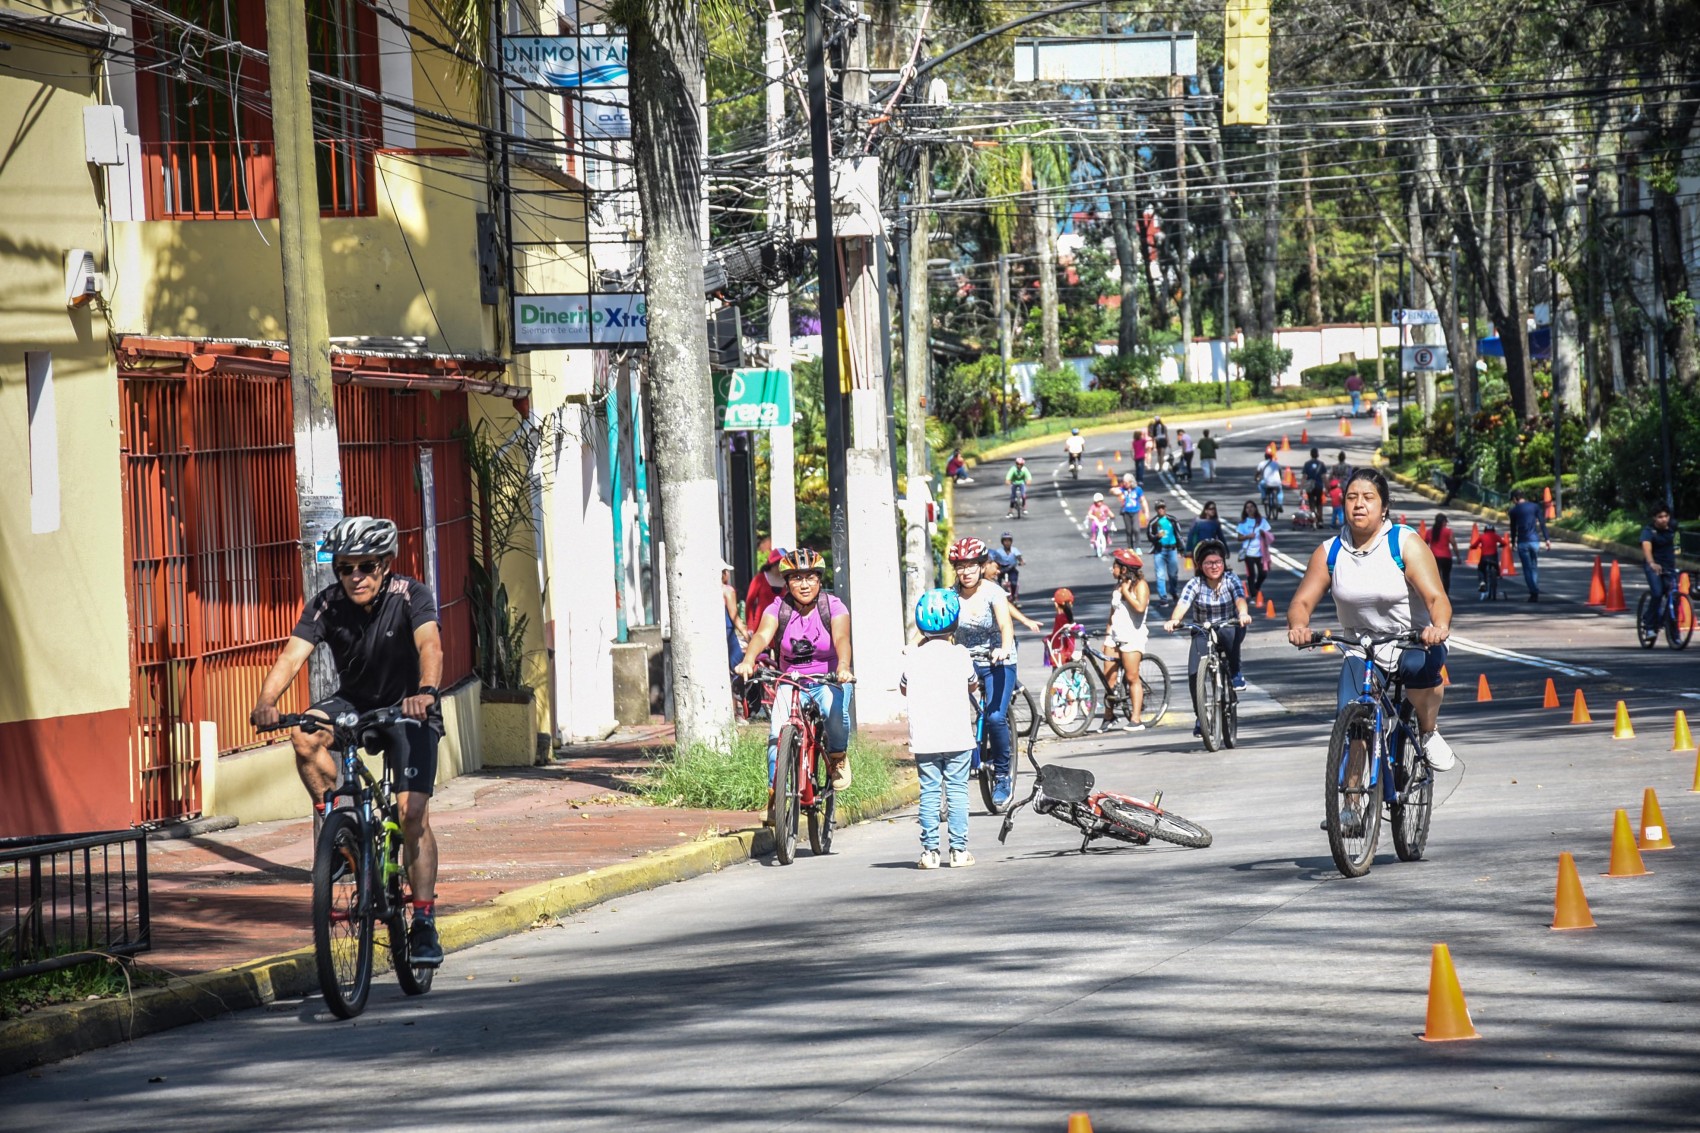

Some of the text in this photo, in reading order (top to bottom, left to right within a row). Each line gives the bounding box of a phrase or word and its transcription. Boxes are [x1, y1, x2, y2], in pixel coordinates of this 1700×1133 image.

[558, 326, 566, 334] te
[585, 326, 603, 334] ben
[1420, 353, 1427, 362] E
